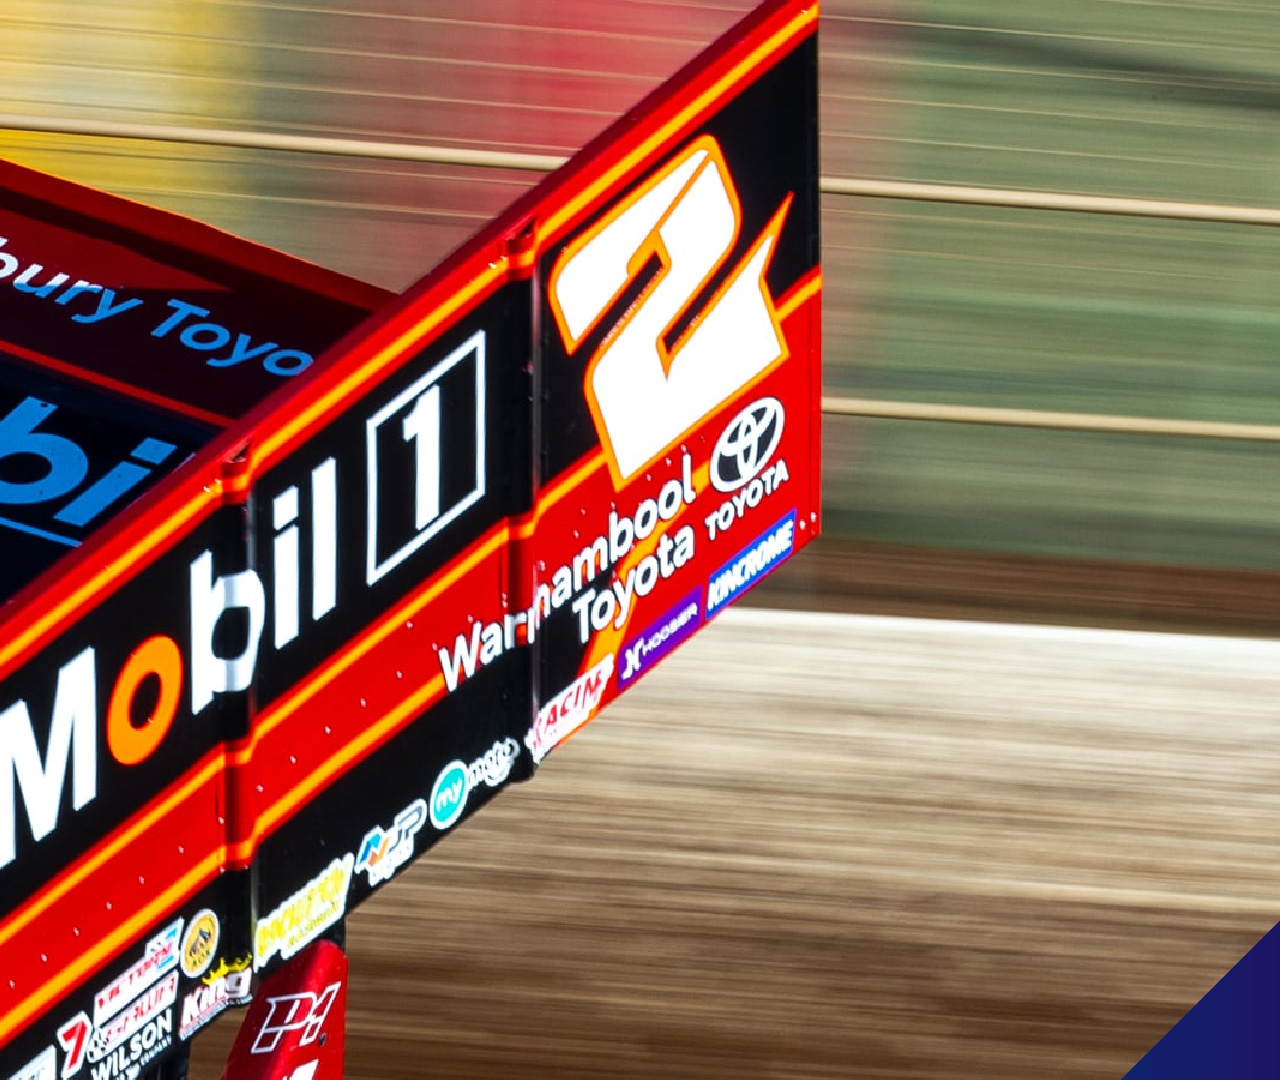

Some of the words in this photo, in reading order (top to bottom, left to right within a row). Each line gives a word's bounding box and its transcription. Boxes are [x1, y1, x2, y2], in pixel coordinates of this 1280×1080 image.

[547, 135, 794, 492] 2
[402, 385, 441, 532] 1
[705, 457, 790, 541] TOYOTA
[572, 524, 696, 645] Toyota
[707, 518, 794, 609] KINCROME
